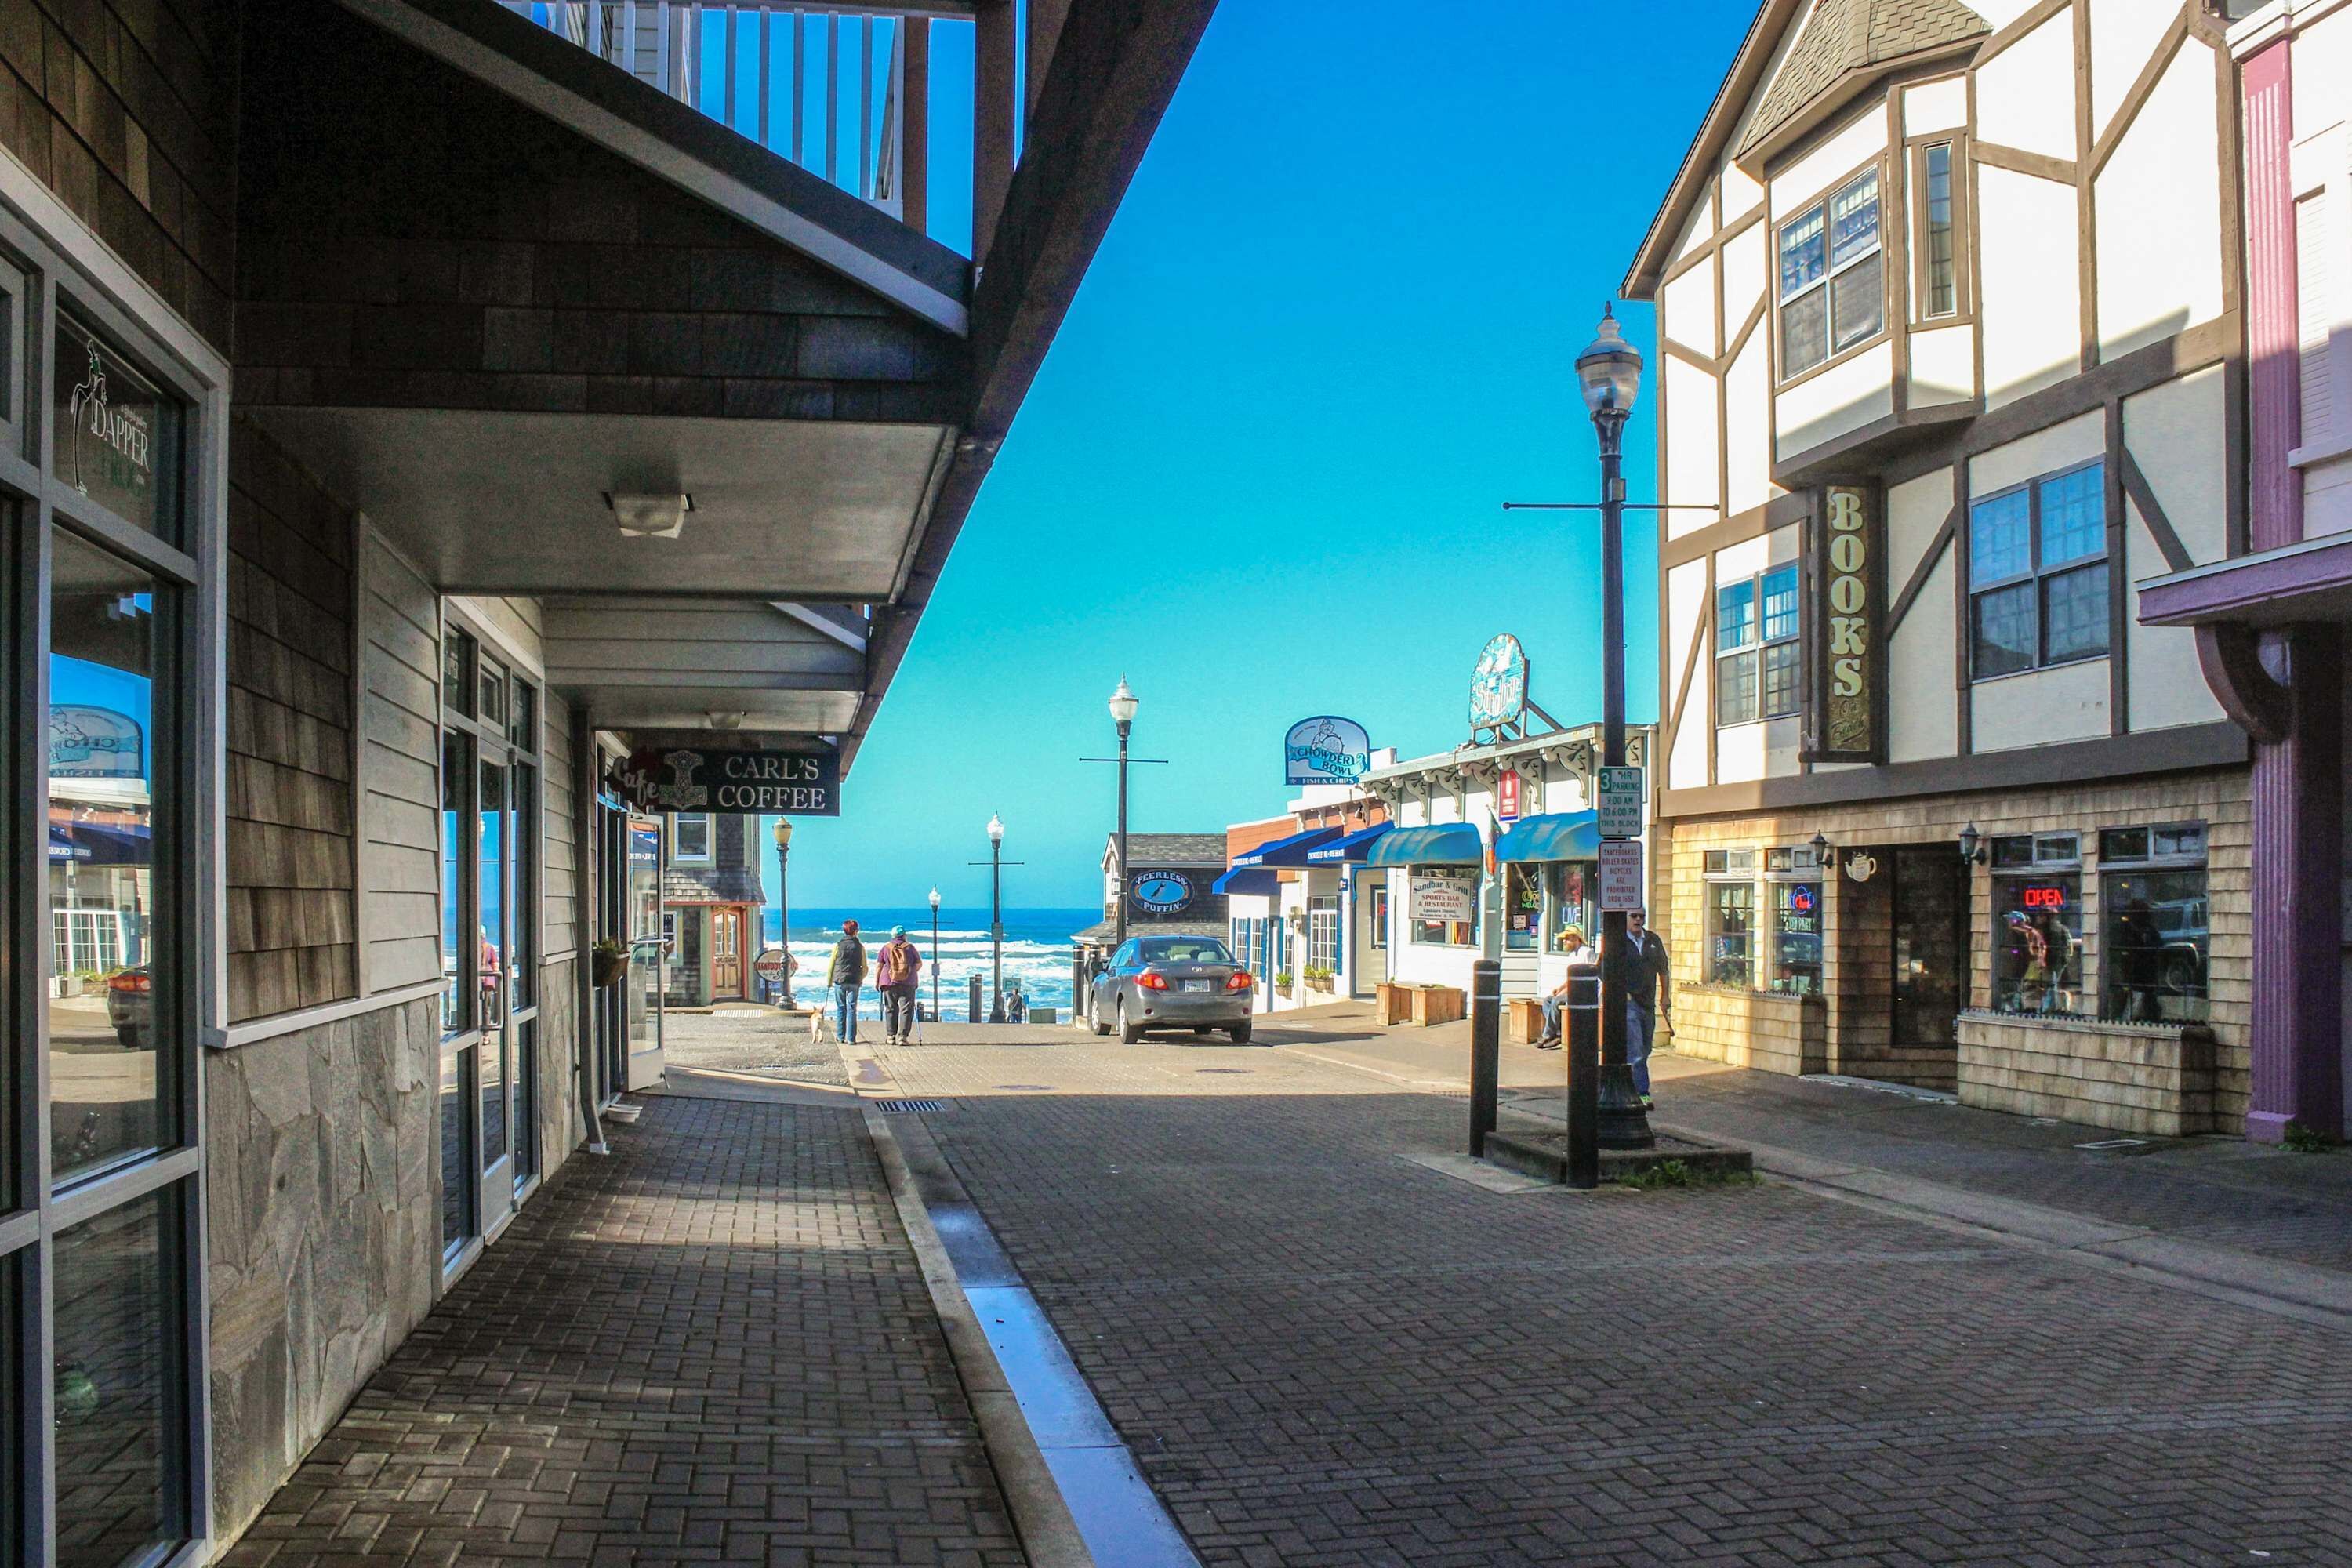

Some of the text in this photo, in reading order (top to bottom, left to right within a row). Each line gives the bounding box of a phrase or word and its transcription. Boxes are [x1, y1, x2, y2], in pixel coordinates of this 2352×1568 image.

[93, 399, 150, 473] DAPPER
[1830, 492, 1866, 697] BOOKS
[1297, 747, 1350, 765] CHOWDER
[725, 756, 820, 780] CARL'S
[1321, 760, 1353, 775] BOWL
[612, 755, 659, 806] Cafe
[1601, 772, 1610, 789] 3
[1611, 782, 1639, 791] PARKING
[717, 785, 826, 810] COFFEE
[1606, 796, 1633, 804] 9:00 AM
[1602, 808, 1638, 816] TO 6:00 PM
[1137, 871, 1186, 886] PEERLESS
[1414, 880, 1443, 893] Sandbar
[2025, 888, 2063, 906] OPEN
[1144, 902, 1180, 913] PUFFIN
